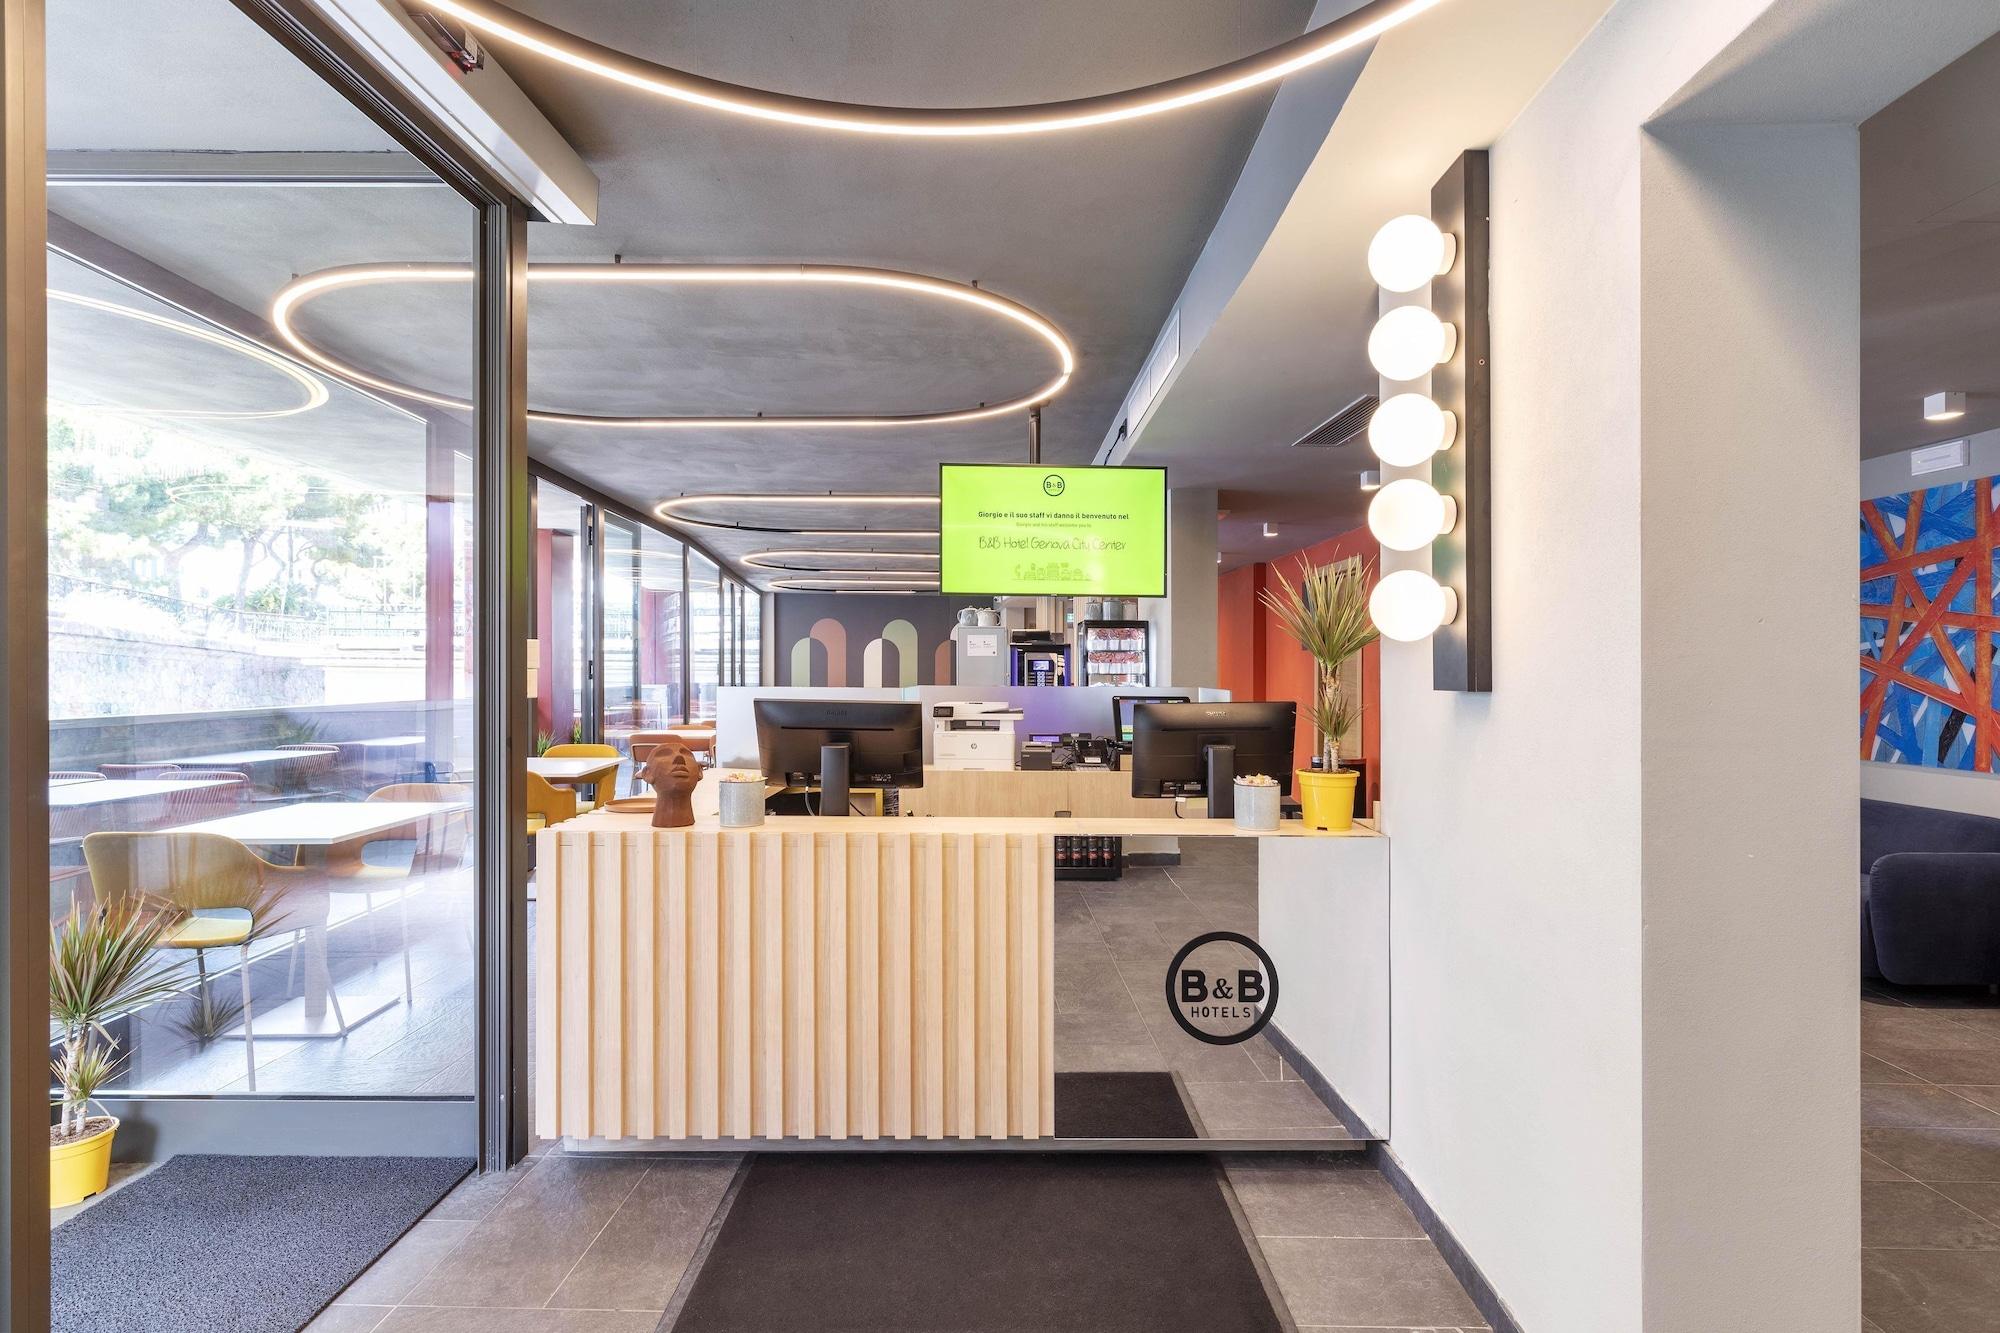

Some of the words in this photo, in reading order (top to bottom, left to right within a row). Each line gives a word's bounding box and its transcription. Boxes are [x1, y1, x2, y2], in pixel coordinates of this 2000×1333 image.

[978, 511, 1003, 519] Giorgio
[1046, 511, 1052, 519] vi
[1082, 512, 1117, 520] benvenuto
[979, 536, 1000, 549] B&B
[1003, 536, 1029, 549] Hotel
[1031, 536, 1070, 550] Genova
[1072, 537, 1089, 551] City
[1092, 537, 1126, 551] Center
[1191, 1006, 1251, 1018] HOTELS
